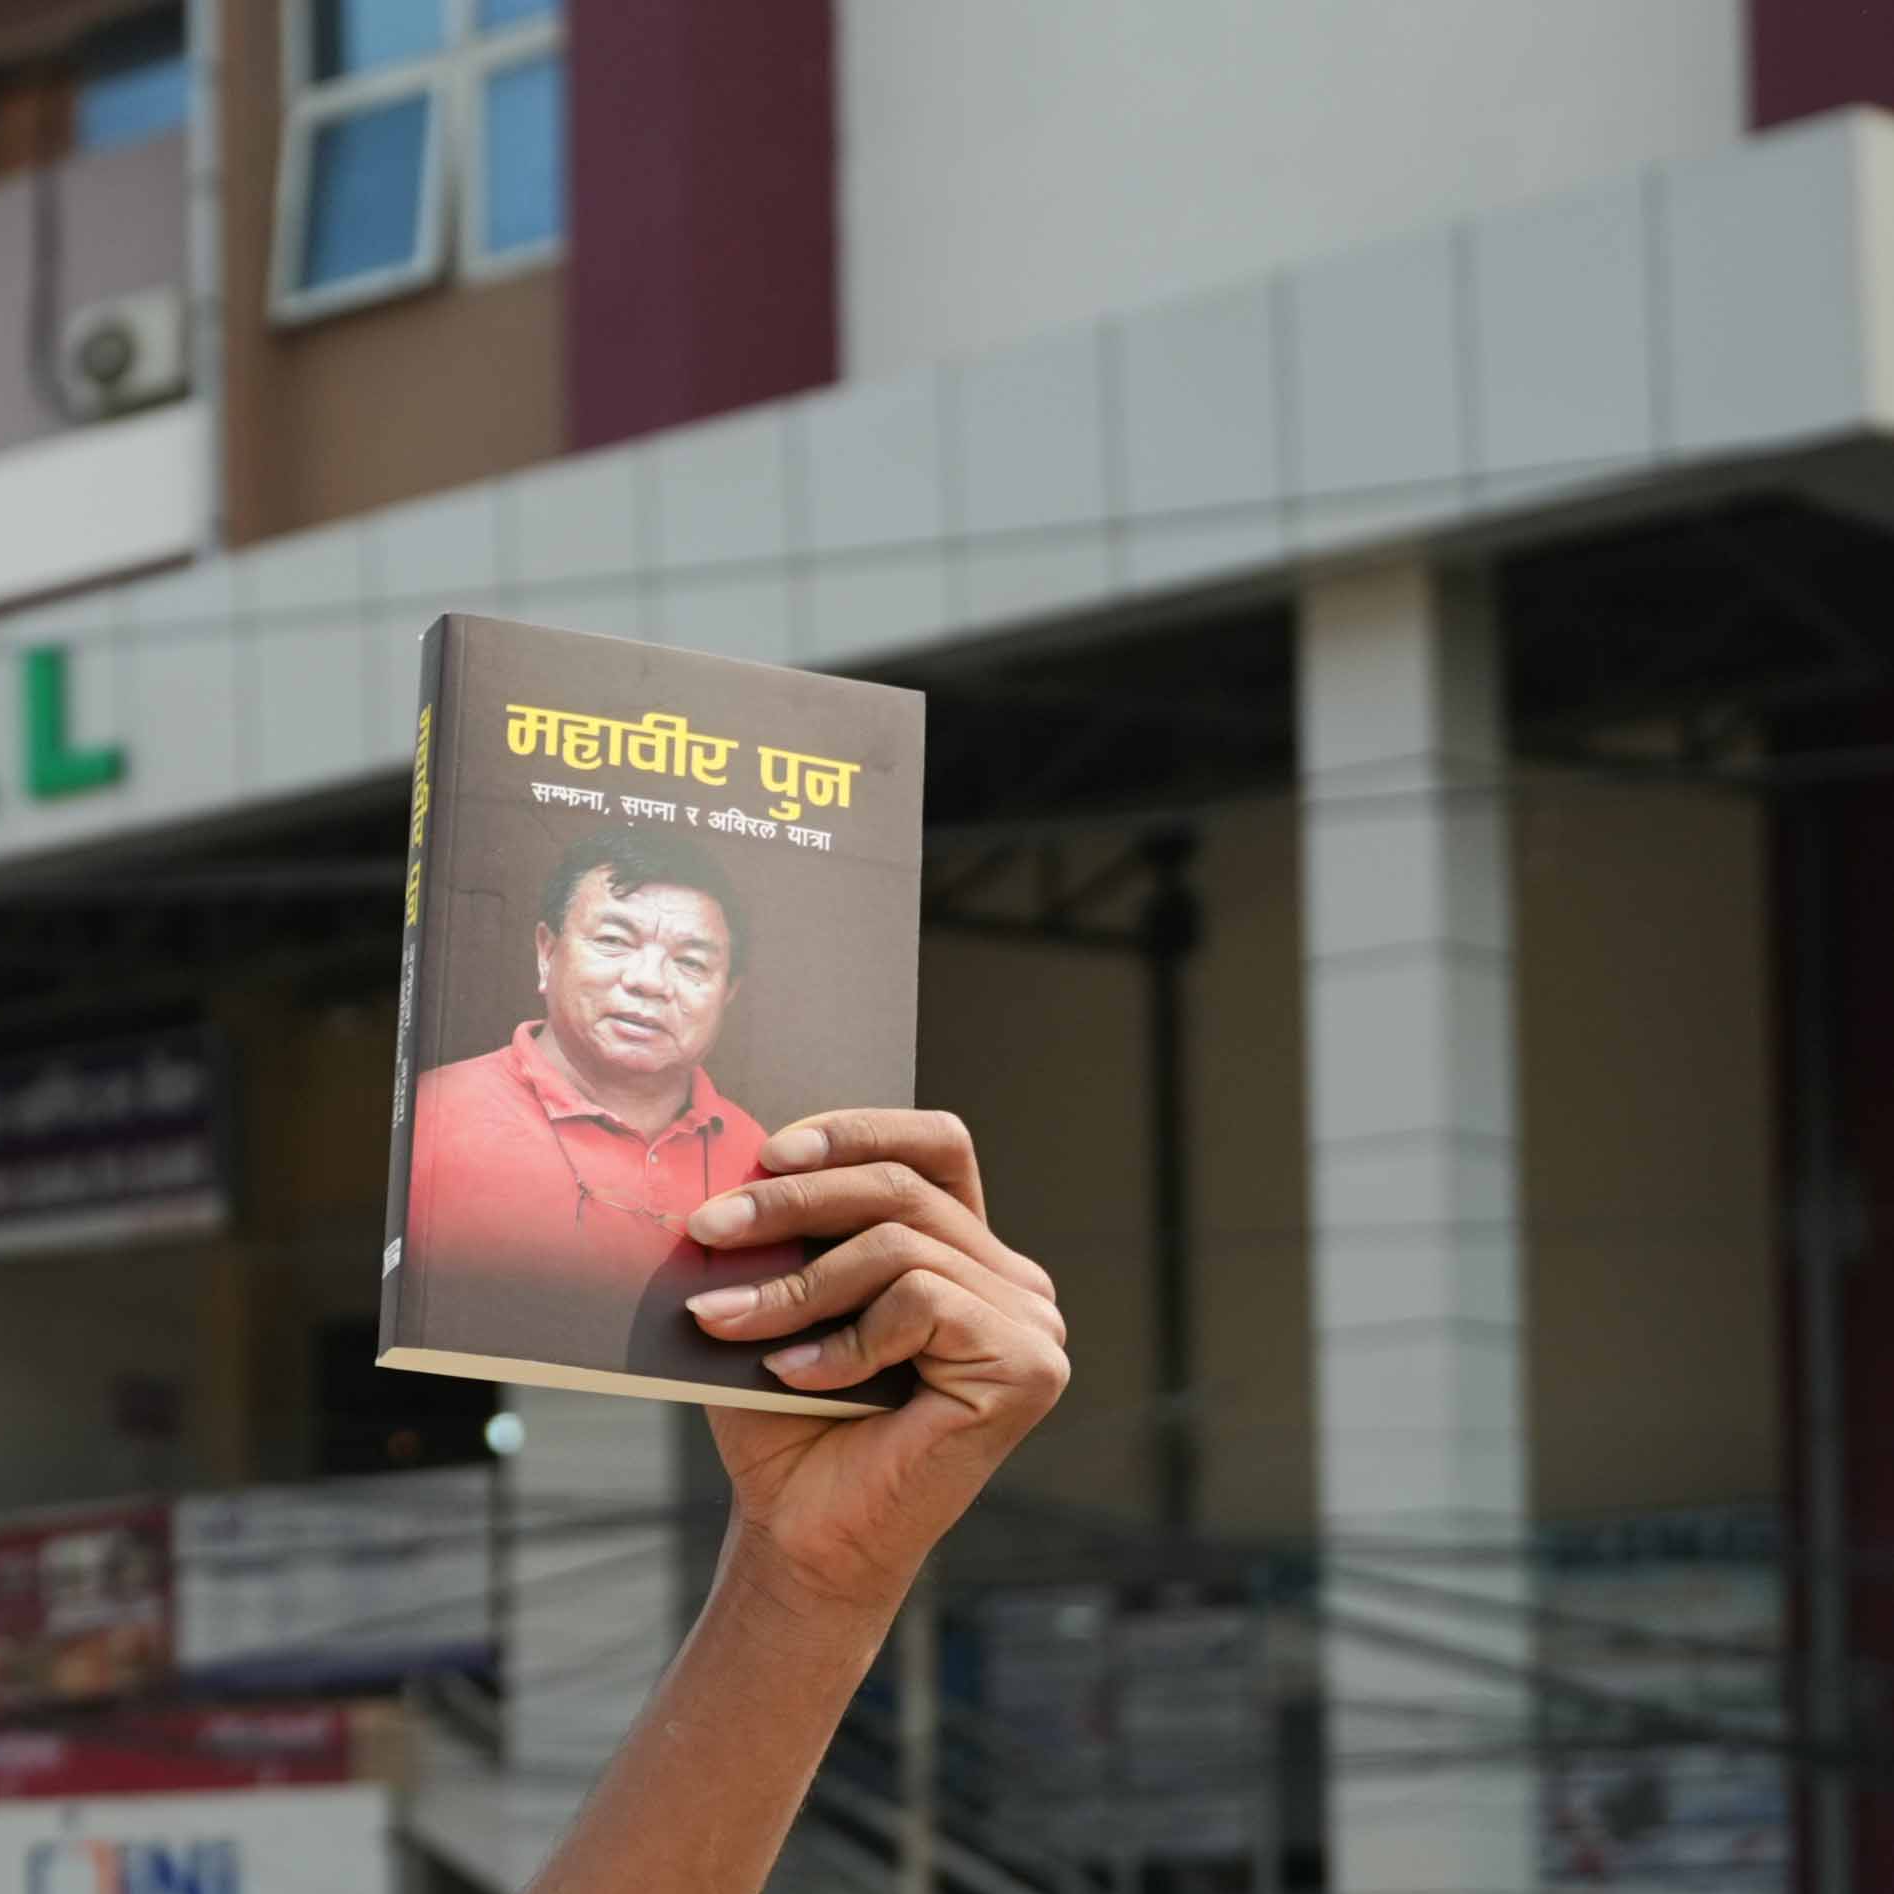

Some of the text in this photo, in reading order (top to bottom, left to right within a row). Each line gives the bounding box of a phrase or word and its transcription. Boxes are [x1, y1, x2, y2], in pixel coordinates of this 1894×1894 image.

[505, 703, 860, 821] महावीर पुन
[620, 795, 676, 823] सपना
[685, 806, 700, 826] र
[708, 808, 778, 840] अविरल
[785, 823, 832, 851] यात्रा
